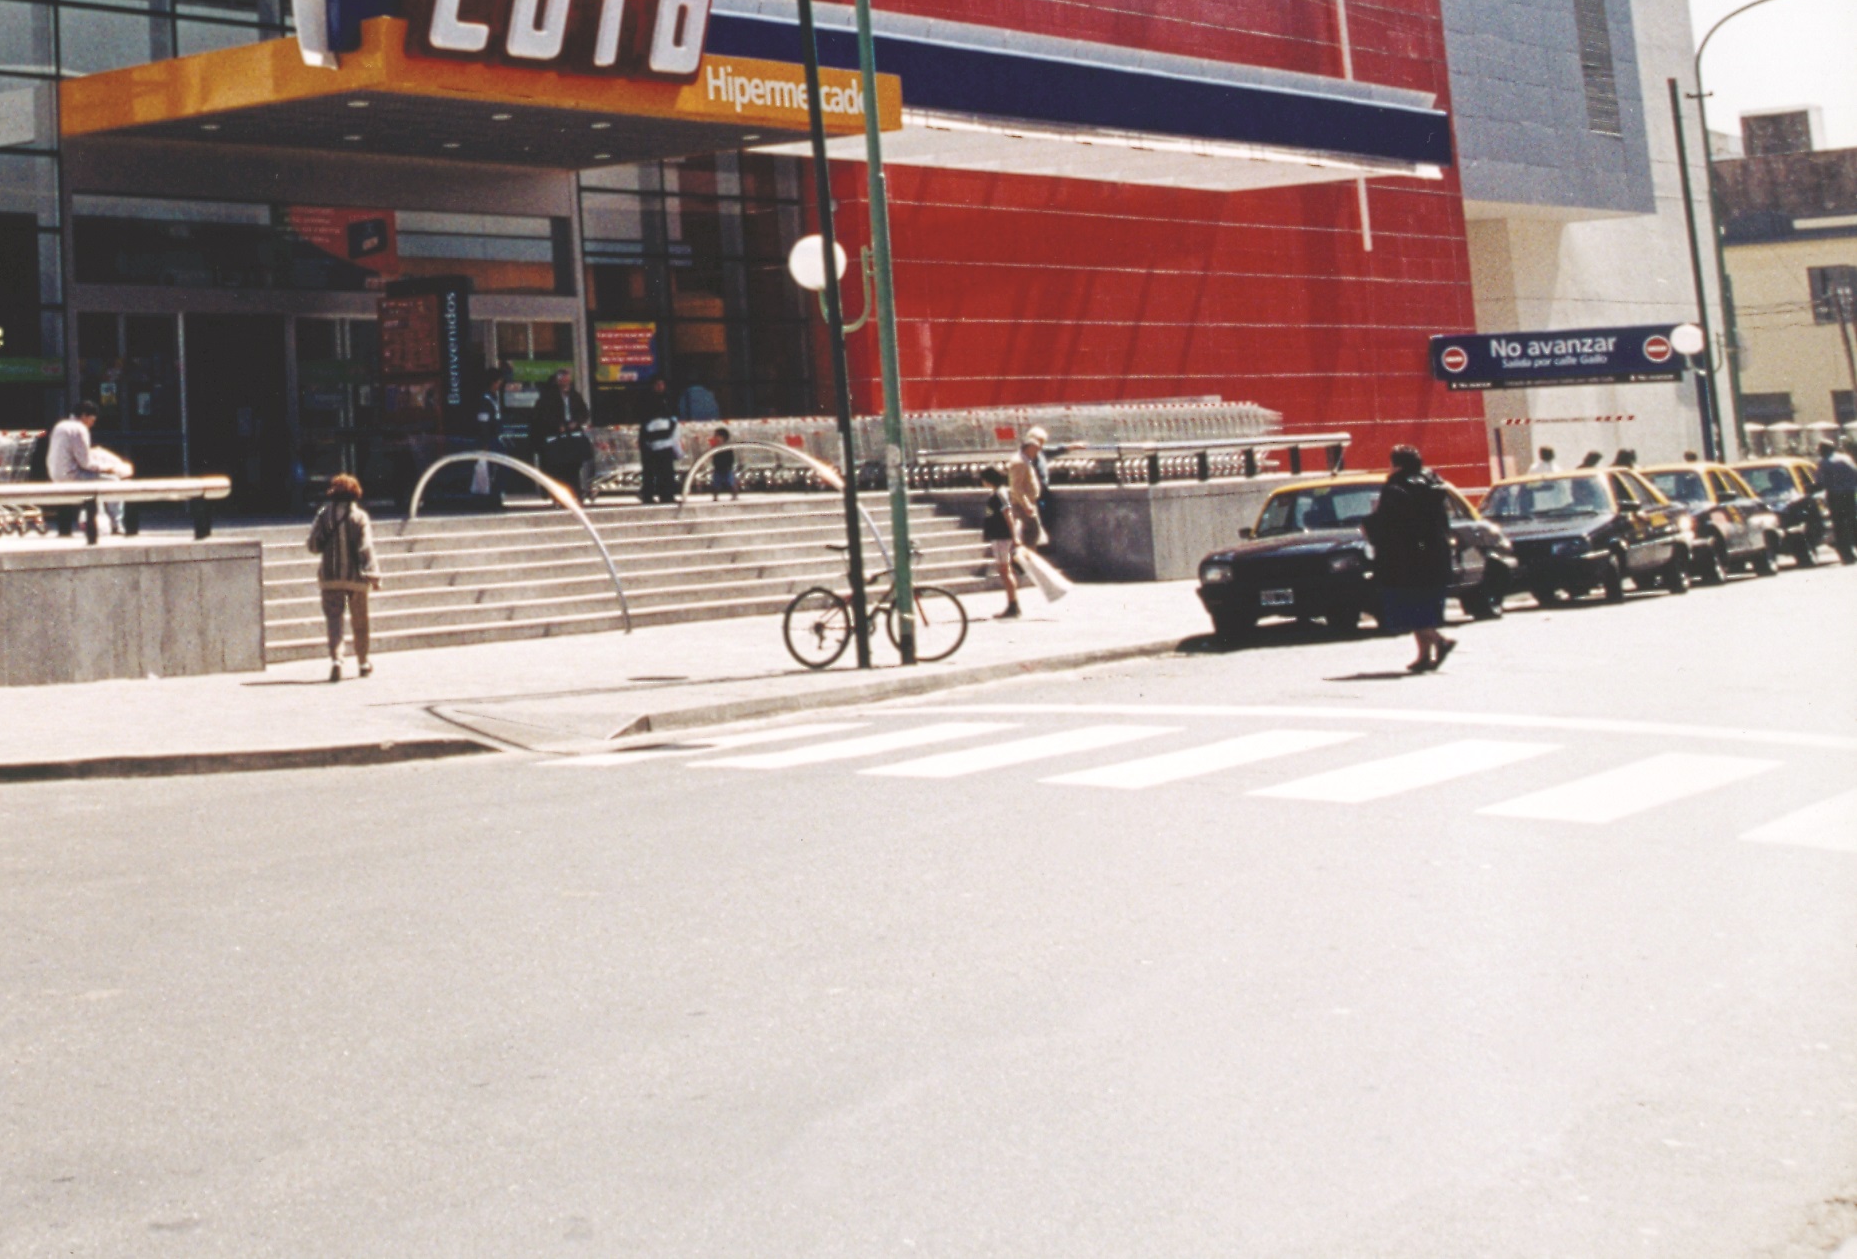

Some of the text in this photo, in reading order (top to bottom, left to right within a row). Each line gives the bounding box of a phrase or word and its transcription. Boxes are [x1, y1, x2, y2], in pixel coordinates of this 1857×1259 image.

[706, 65, 867, 115] Hipermecad
[444, 291, 461, 404] Bienvenidos
[1489, 336, 1617, 358] No avanzar
[1502, 353, 1608, 369] Salida por calle Gallo
